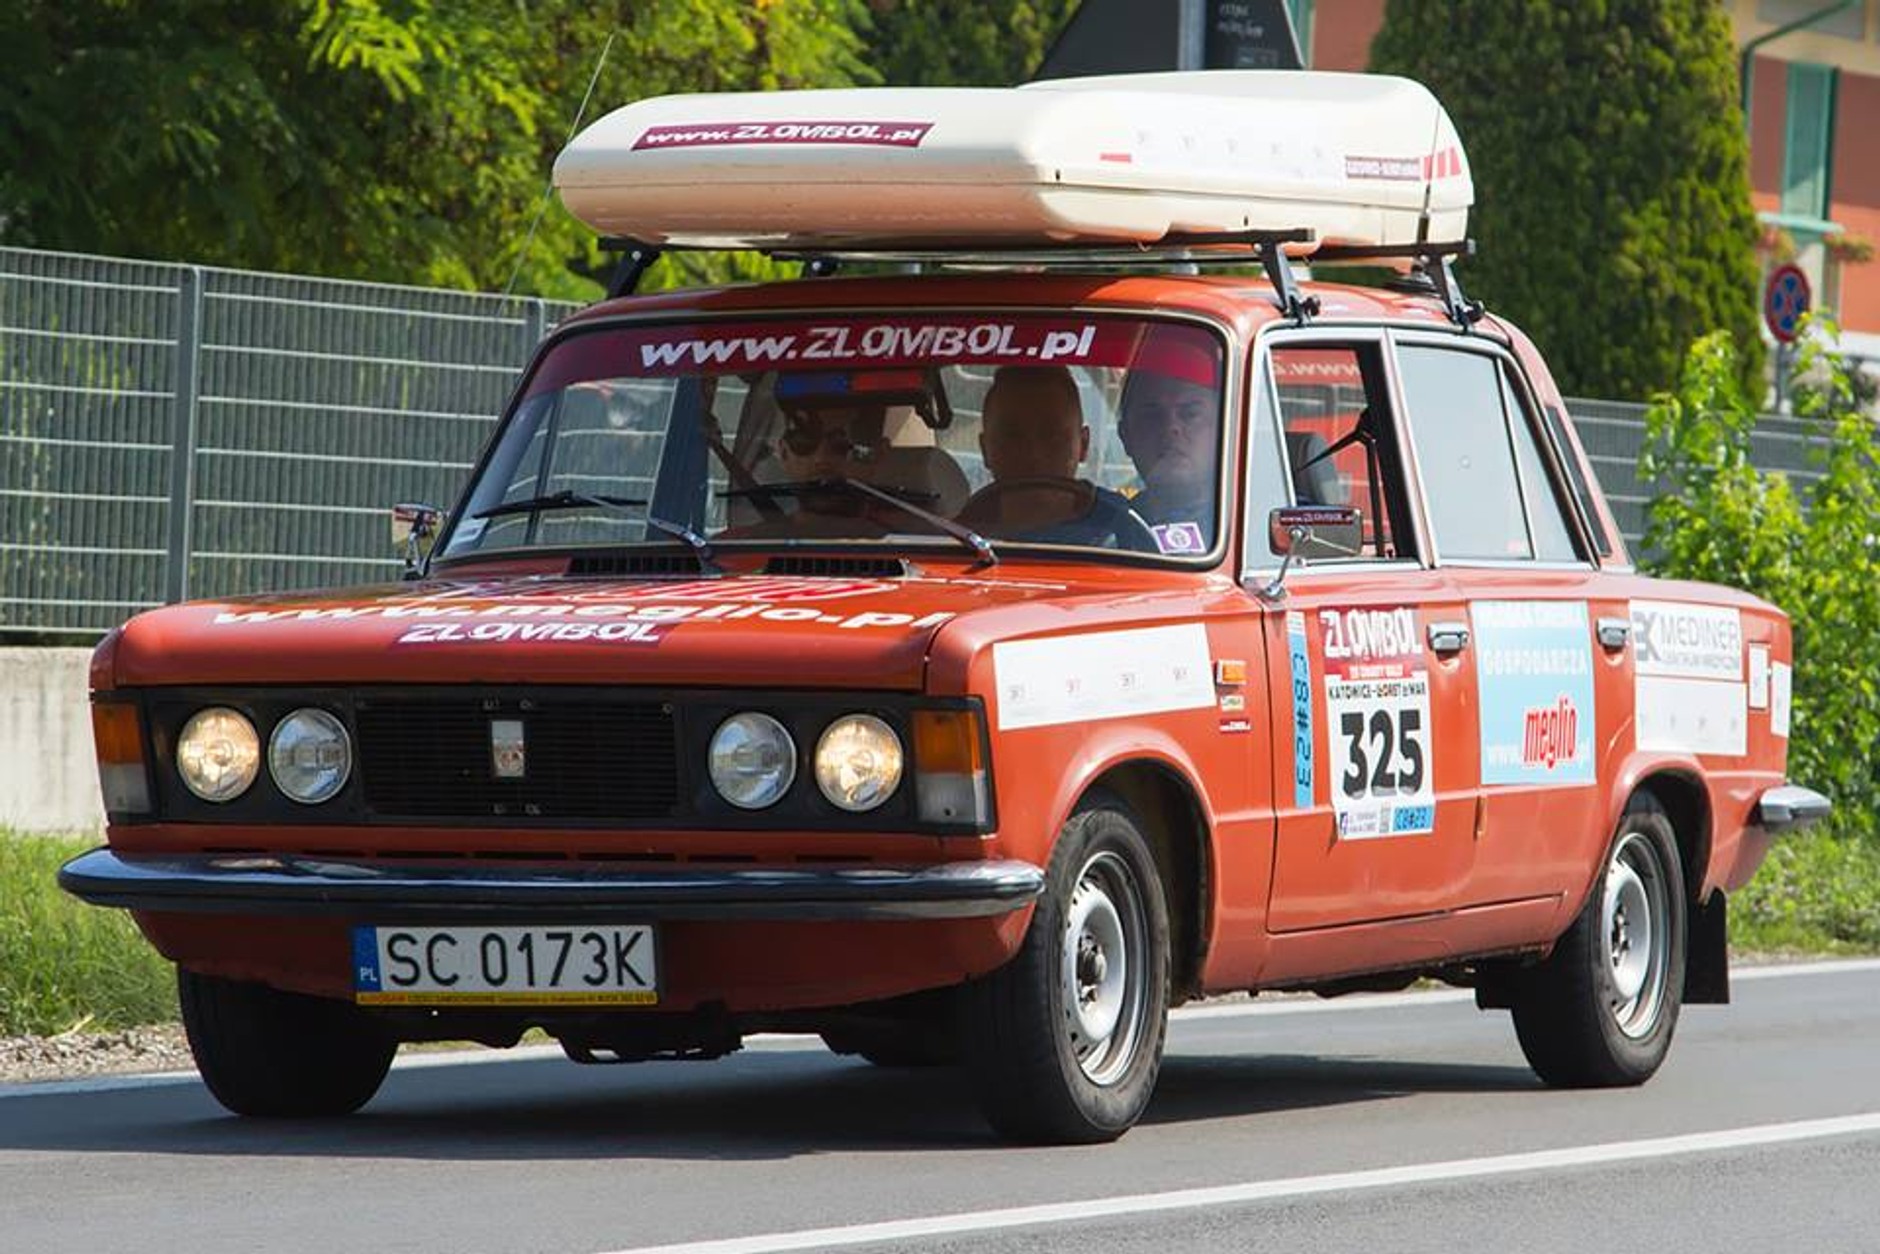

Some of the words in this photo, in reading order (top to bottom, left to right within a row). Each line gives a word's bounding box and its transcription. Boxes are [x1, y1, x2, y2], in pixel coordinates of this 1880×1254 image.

[646, 123, 921, 143] www.ZLOMBOL.pl
[640, 325, 1097, 367] www.ZLOMBOL.pl
[212, 598, 960, 630] www.meglio.pl
[398, 622, 661, 644] ZLOMBOL
[1320, 607, 1423, 658] ZLOMBOL
[1341, 709, 1424, 799] 325
[1522, 698, 1578, 769] meglio
[360, 967, 378, 982] PL
[386, 932, 460, 987] SC
[479, 931, 647, 987] 0173K
